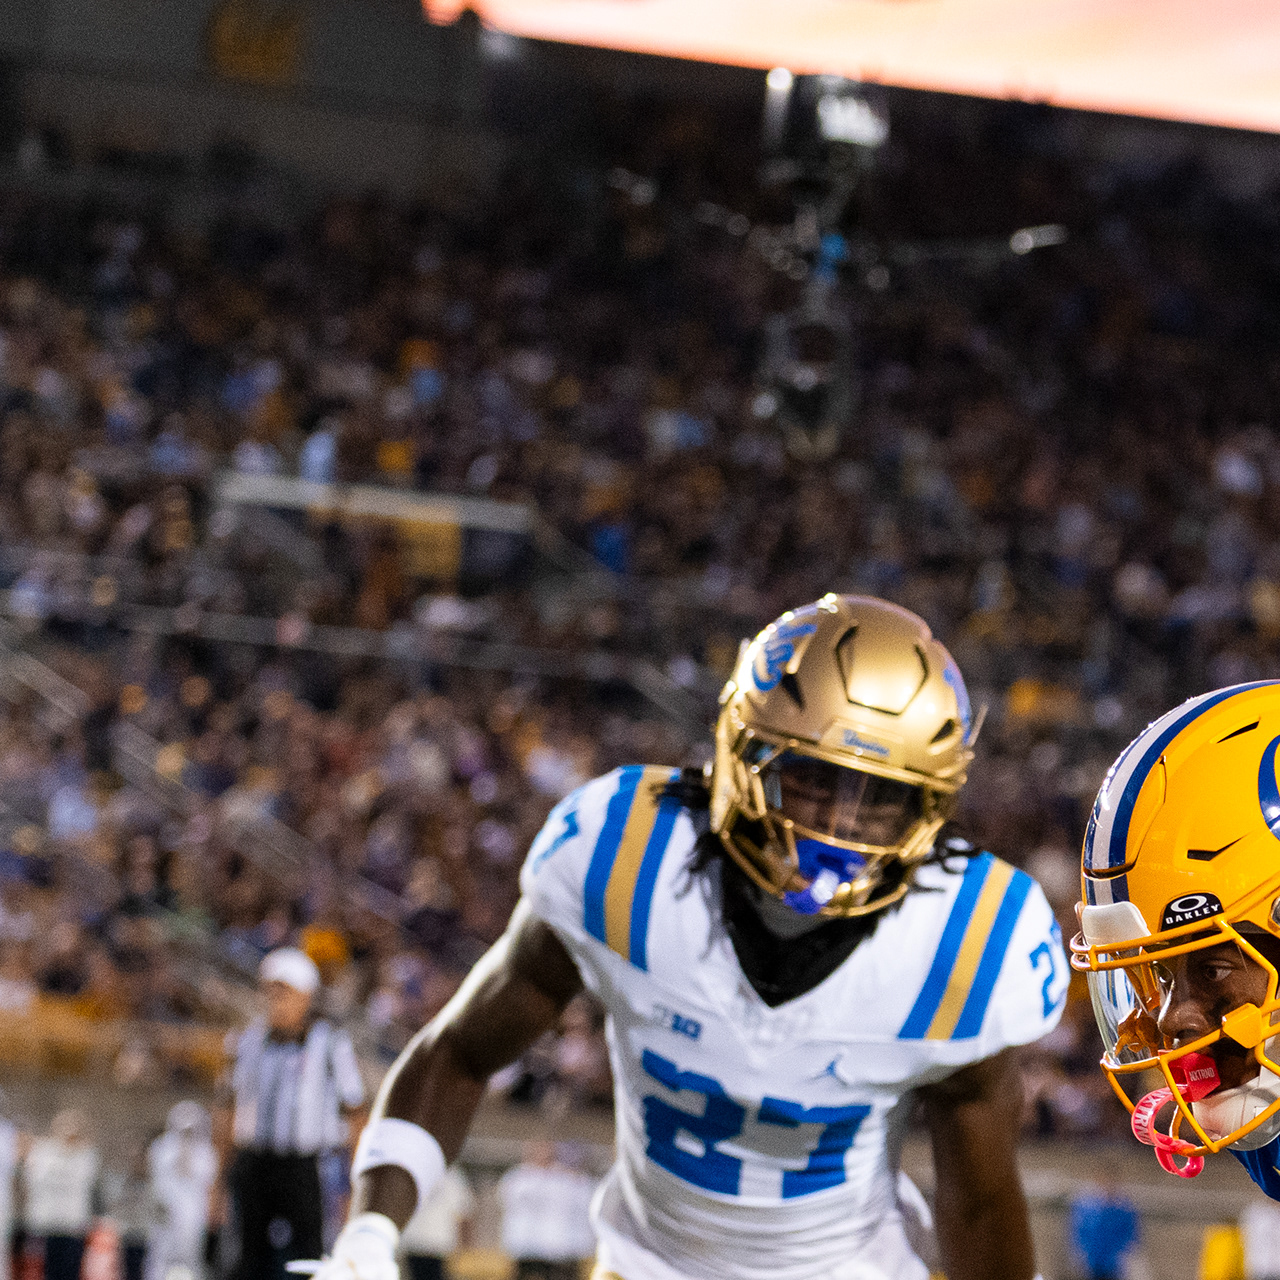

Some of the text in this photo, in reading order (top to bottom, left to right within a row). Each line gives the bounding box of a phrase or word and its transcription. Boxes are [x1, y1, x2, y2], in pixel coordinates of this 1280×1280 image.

[1165, 904, 1220, 925] OAKLEY
[1188, 1066, 1215, 1082] NXTRND
[641, 1048, 872, 1200] 27
